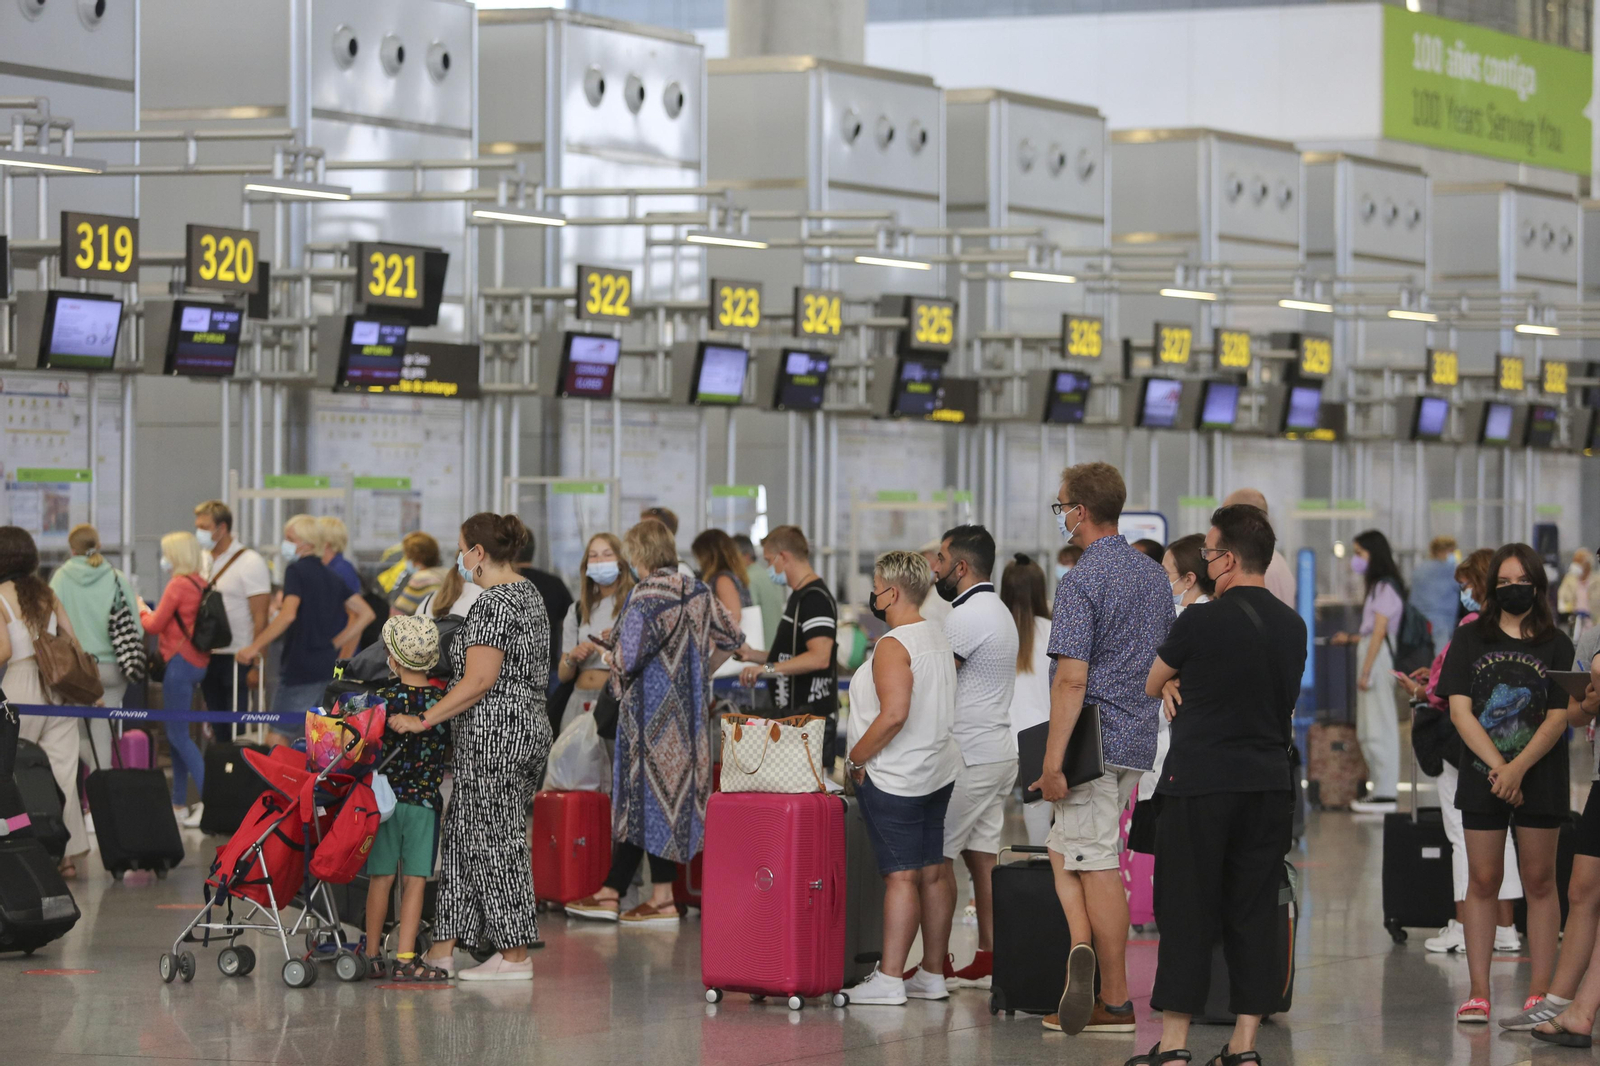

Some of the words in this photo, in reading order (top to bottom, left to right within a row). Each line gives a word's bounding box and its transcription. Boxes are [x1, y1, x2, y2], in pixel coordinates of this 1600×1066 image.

[1412, 32, 1443, 74] 100
[1484, 54, 1537, 102] contigo
[1412, 87, 1441, 129] 100
[75, 222, 133, 273] 319
[198, 234, 254, 284] 320
[368, 251, 418, 299] 321
[586, 272, 631, 317] 322
[718, 286, 760, 328] 323
[801, 294, 842, 335] 324
[915, 305, 954, 345] 325
[1067, 319, 1102, 357] 326
[1160, 328, 1192, 364] 327
[1219, 332, 1251, 367] 328
[1302, 339, 1332, 374] 329
[1473, 651, 1548, 679] MYSTICAL
[109, 710, 148, 719] FINNAIR
[241, 713, 280, 722] FINNAIR
